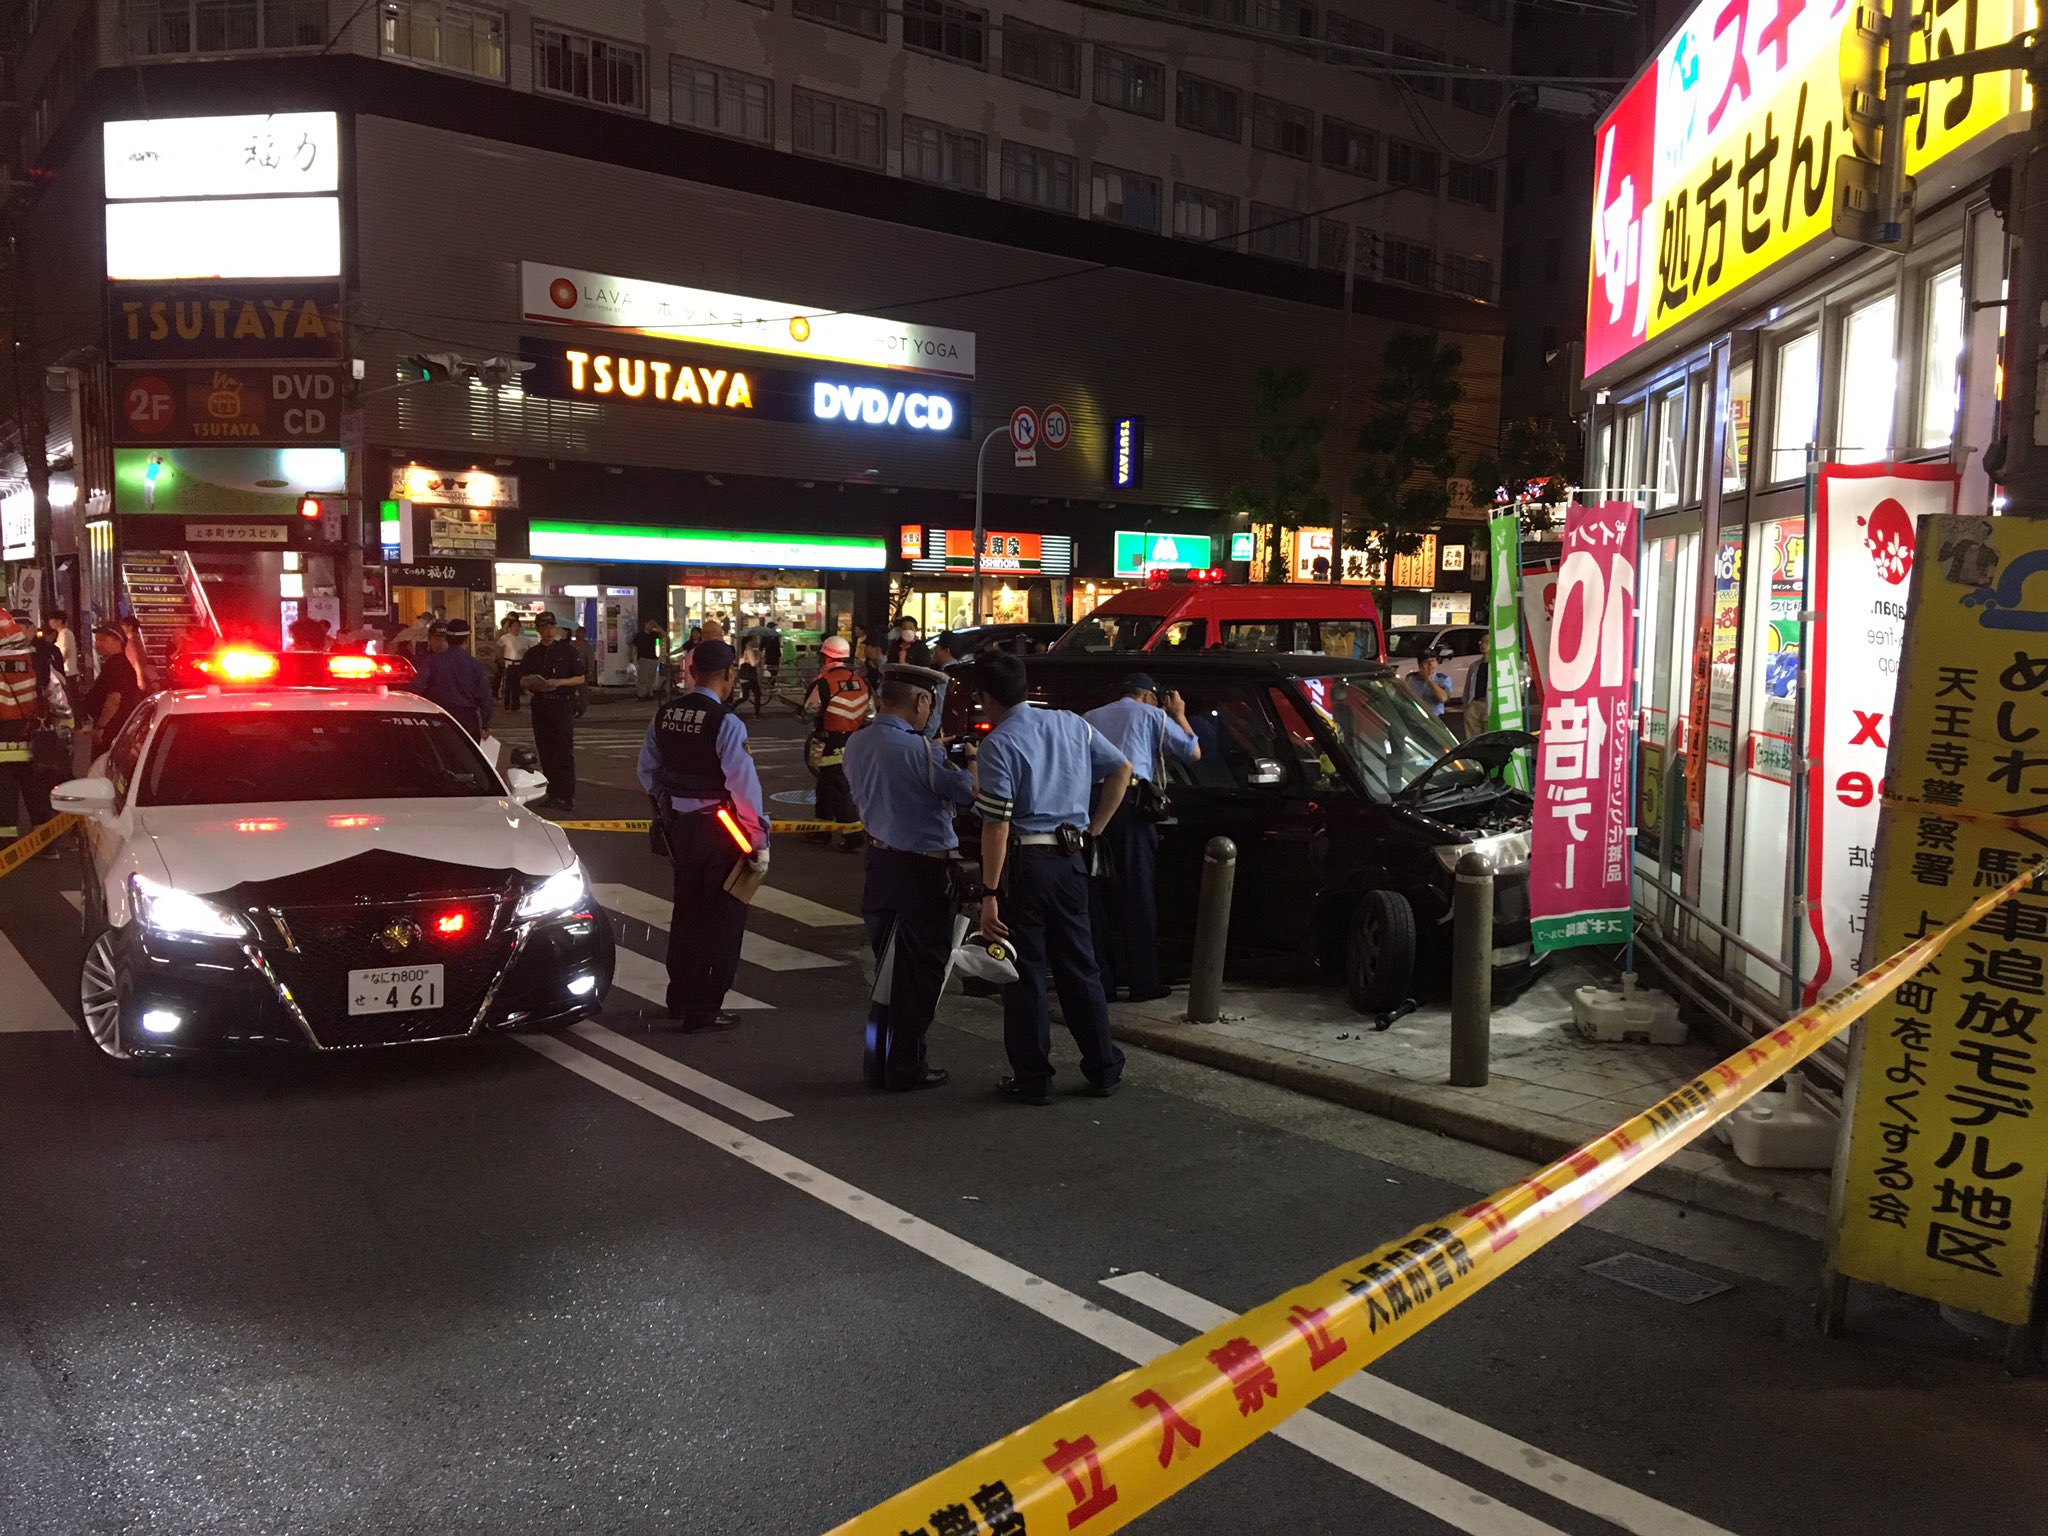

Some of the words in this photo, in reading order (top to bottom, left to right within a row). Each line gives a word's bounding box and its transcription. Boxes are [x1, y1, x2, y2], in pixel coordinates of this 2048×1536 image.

[1594, 125, 1652, 337] くすり
[584, 285, 633, 305] LAVA
[123, 299, 327, 341] TSUTAYA
[913, 339, 959, 360] YOGA
[272, 374, 335, 400] DVD
[565, 350, 754, 409] TSUTAYA
[129, 389, 171, 421] 2F
[812, 381, 954, 431] DVD/CD
[194, 422, 261, 437] TSUTAYA
[284, 408, 326, 435] CD
[1047, 417, 1064, 438] 50
[1118, 419, 1131, 485] TSUTAYA
[194, 528, 279, 540] 上本町サウスビル
[661, 721, 703, 734] POLICE
[663, 706, 707, 725] 大阪府警
[1910, 666, 1979, 888] 天王寺警察署
[355, 994, 366, 1007] せ
[1043, 1304, 1348, 1530] 立入禁止
